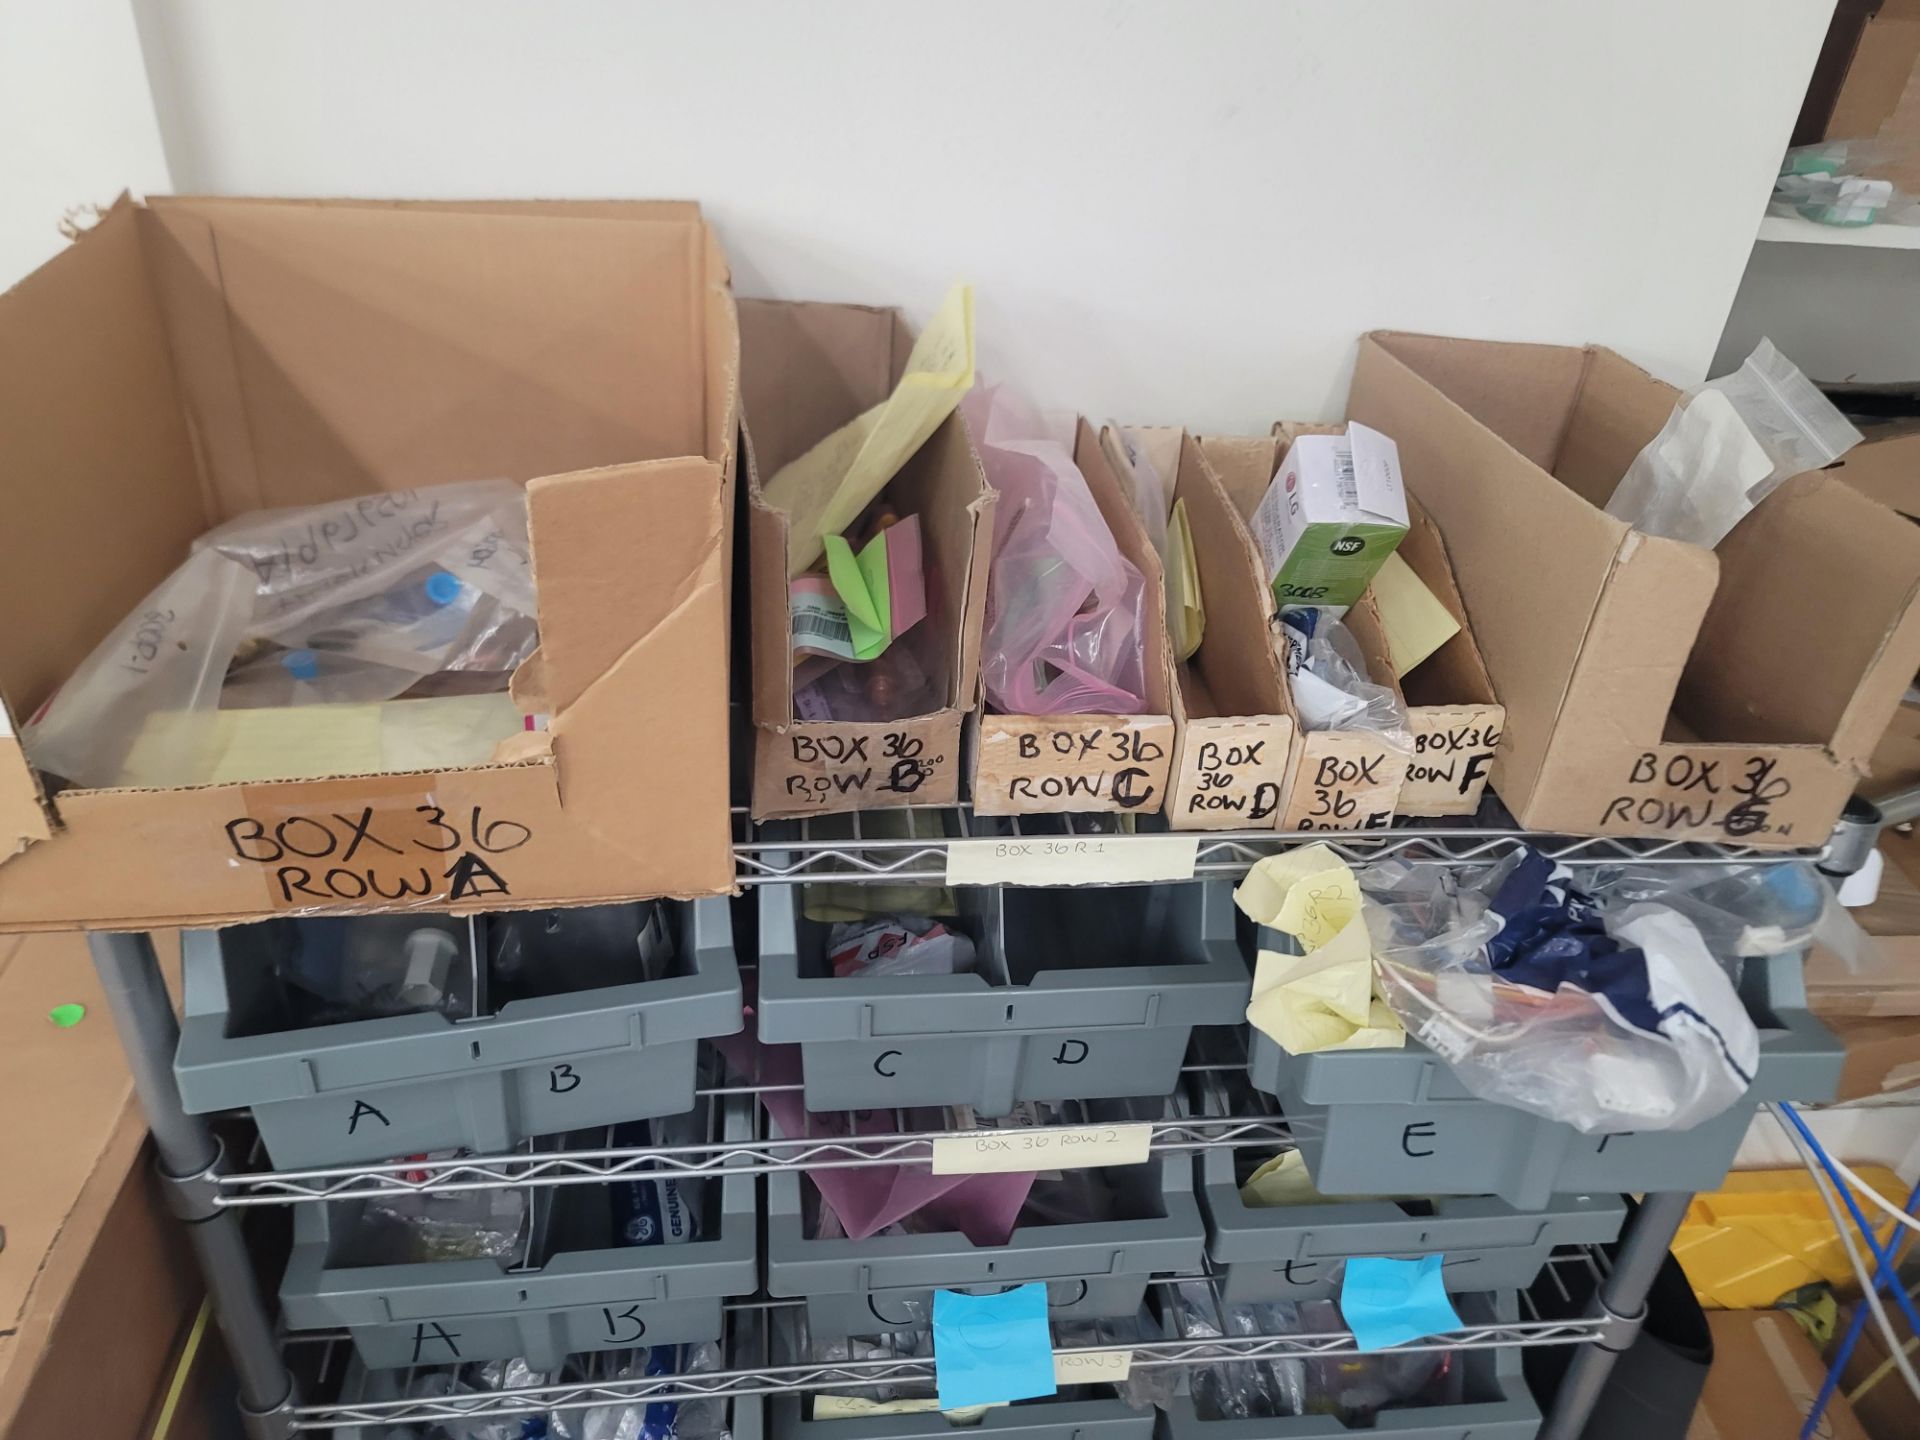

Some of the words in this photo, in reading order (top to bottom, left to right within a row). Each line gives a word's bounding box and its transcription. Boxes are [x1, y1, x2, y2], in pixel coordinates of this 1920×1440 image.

[1288, 491, 1299, 516] LG
[1334, 539, 1362, 553] NSF
[793, 735, 869, 764] BOX
[883, 731, 924, 759] 36
[1019, 729, 1102, 761] BOX
[1107, 729, 1164, 762] 36
[1198, 740, 1265, 771] BOX
[1414, 726, 1470, 756] BOX
[1466, 724, 1501, 748] 36
[785, 767, 872, 796] ROW
[875, 758, 926, 793] B
[1009, 770, 1105, 801] ROW
[1196, 772, 1233, 791] 36
[1314, 754, 1386, 788] BOX
[1458, 751, 1495, 795] F
[1629, 752, 1720, 794] BOX
[1189, 793, 1246, 814] ROW
[1308, 789, 1357, 819] 36
[1600, 796, 1714, 830] ROW
[224, 806, 403, 863] BOX
[412, 805, 532, 853] 36
[995, 843, 1033, 858] BOX
[1043, 842, 1070, 856] 36
[1075, 841, 1088, 854] R
[1096, 842, 1106, 854] 1
[276, 866, 431, 902] ROW
[443, 851, 511, 901] A
[873, 1049, 903, 1079] C
[1052, 1039, 1090, 1066] D
[549, 1064, 581, 1093] B
[347, 1100, 391, 1135] A
[975, 1138, 1012, 1152] BOX
[1023, 1136, 1049, 1149] 36
[1060, 1132, 1099, 1147] ROW
[1105, 1130, 1120, 1143] 2
[1401, 1121, 1437, 1158] E
[665, 1178, 683, 1237] GENUINE
[603, 1305, 647, 1344] B
[412, 1322, 462, 1362] A
[1060, 1355, 1104, 1367] ROW
[1107, 1354, 1124, 1368] 3
